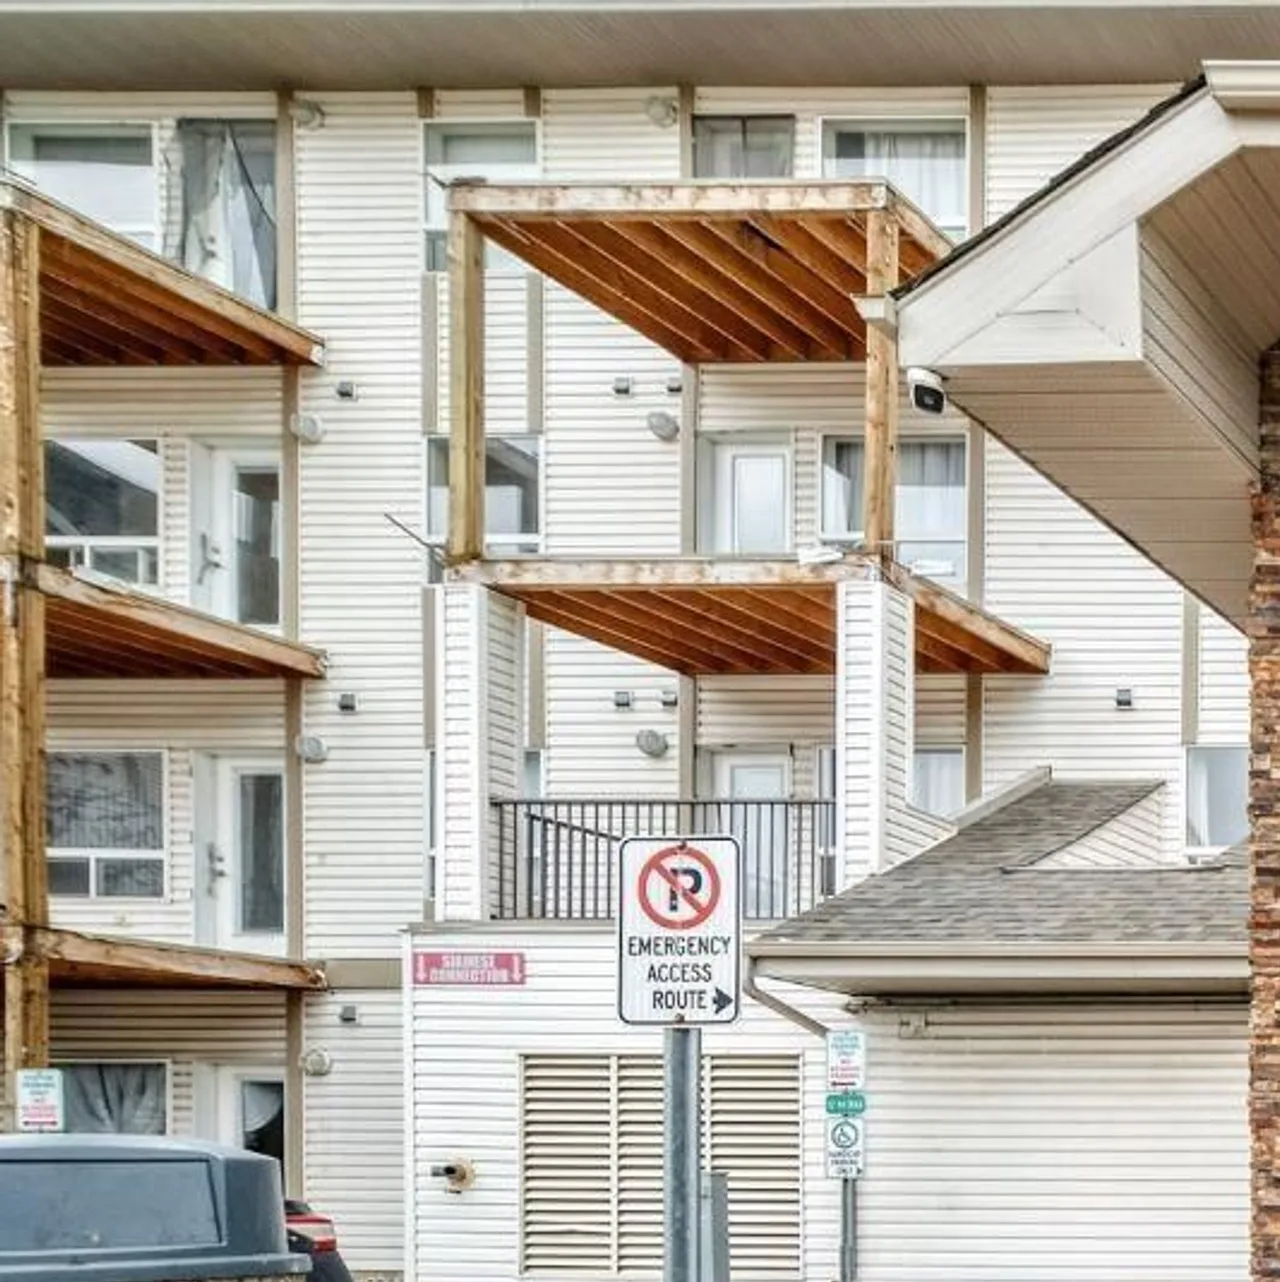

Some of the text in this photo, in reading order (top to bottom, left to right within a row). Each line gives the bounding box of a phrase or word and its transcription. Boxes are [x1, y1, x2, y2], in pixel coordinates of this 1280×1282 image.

[627, 935, 731, 956] EMERGENCY
[647, 963, 712, 983] ACCESS
[652, 990, 708, 1010] ROUTE
